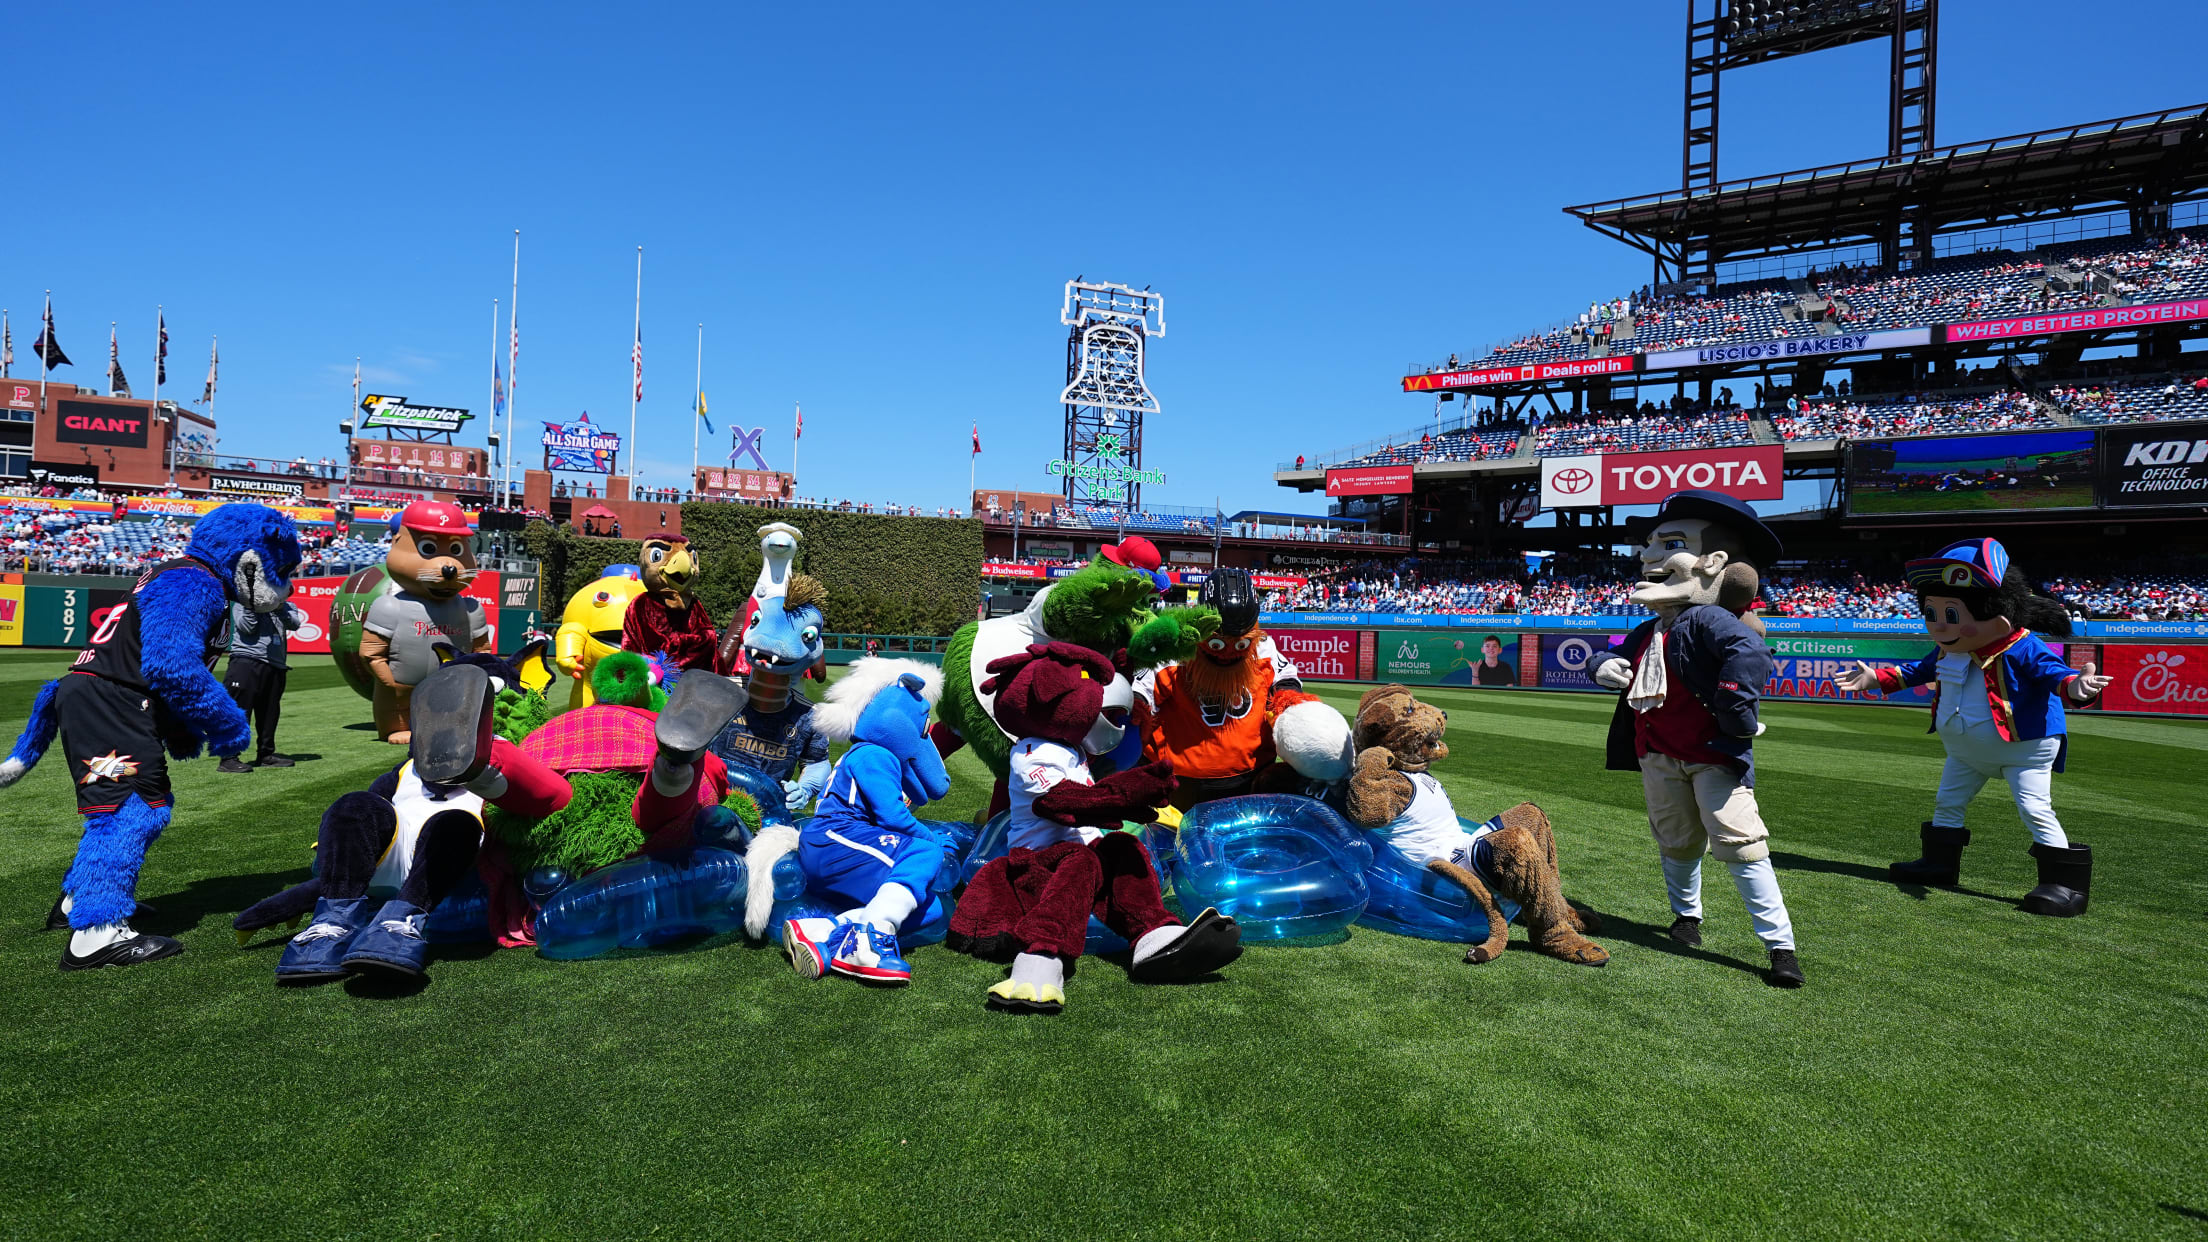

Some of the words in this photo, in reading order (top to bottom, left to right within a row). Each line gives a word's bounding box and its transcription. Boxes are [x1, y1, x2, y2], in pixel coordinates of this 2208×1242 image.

[1956, 321, 2016, 337] WHEY
[2022, 314, 2097, 332] BETTER
[2103, 303, 2199, 324] PROTEIN
[1699, 343, 1780, 363] LISCIO'S
[1786, 335, 1869, 355] BAKERY
[1442, 372, 1487, 387] Phillies
[1489, 370, 1513, 383] win
[1542, 363, 1581, 378] Deals
[1582, 361, 1606, 374] roll
[1608, 360, 1622, 372] in
[370, 397, 463, 421] Fitzpatrick
[64, 415, 141, 434] GIANT
[542, 431, 564, 446] ALL
[564, 434, 590, 448] STAR
[591, 436, 619, 451] GAME
[430, 450, 443, 462] 14
[450, 452, 463, 464] 15
[47, 472, 95, 485] Fanatics
[1049, 459, 1119, 481] Citizens
[1121, 465, 1165, 484] Bank
[1610, 460, 1768, 491] TOYOTA
[2142, 467, 2191, 480] OFFICE
[1088, 481, 1125, 500] Park
[2121, 478, 2208, 493] TECHNOLOGY
[139, 498, 195, 515] Surfside
[439, 514, 449, 526] P
[1949, 568, 1968, 584] P
[298, 586, 306, 594] a
[504, 577, 535, 592] MONTY'S
[505, 592, 528, 607] ANGLE
[62, 589, 76, 643] 387
[1304, 614, 1349, 622] Independence
[1393, 616, 1423, 624] ibx.com
[1460, 616, 1512, 625] Independence
[1563, 617, 1597, 626] ibx.com
[414, 621, 463, 636] Phillies
[1765, 620, 1801, 629] bx.com
[1853, 621, 1924, 630] Independence
[2105, 624, 2192, 635] Independence
[1279, 635, 1350, 658] Temple
[1792, 641, 1854, 654] Citizens
[1569, 648, 1582, 661] R
[1388, 661, 1431, 669] NEMOURS
[1545, 671, 1588, 679] ROTHM
[735, 735, 788, 758] BIMBO
[1029, 765, 1051, 789] T
